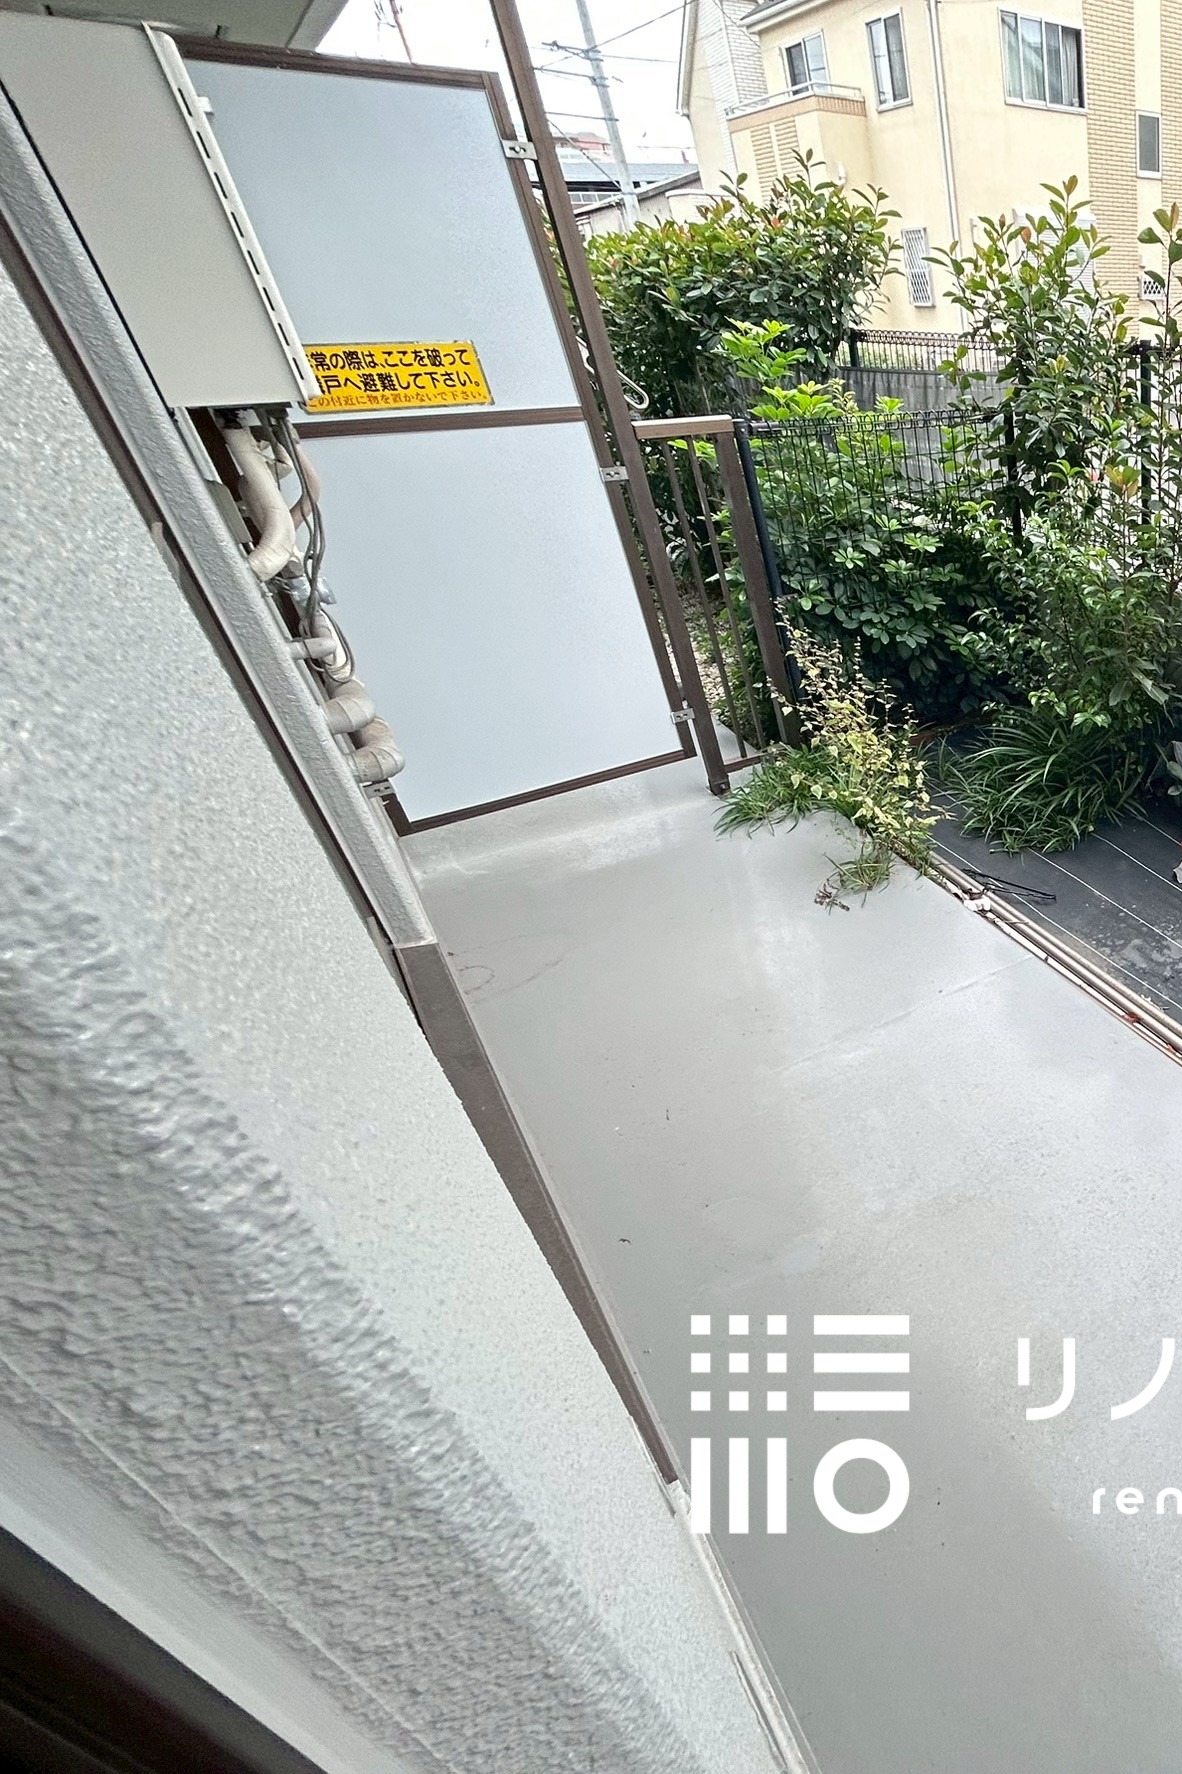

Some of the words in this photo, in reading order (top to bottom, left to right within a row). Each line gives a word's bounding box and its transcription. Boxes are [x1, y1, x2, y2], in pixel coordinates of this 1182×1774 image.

[305, 347, 471, 371] 常の際は、ここを破って
